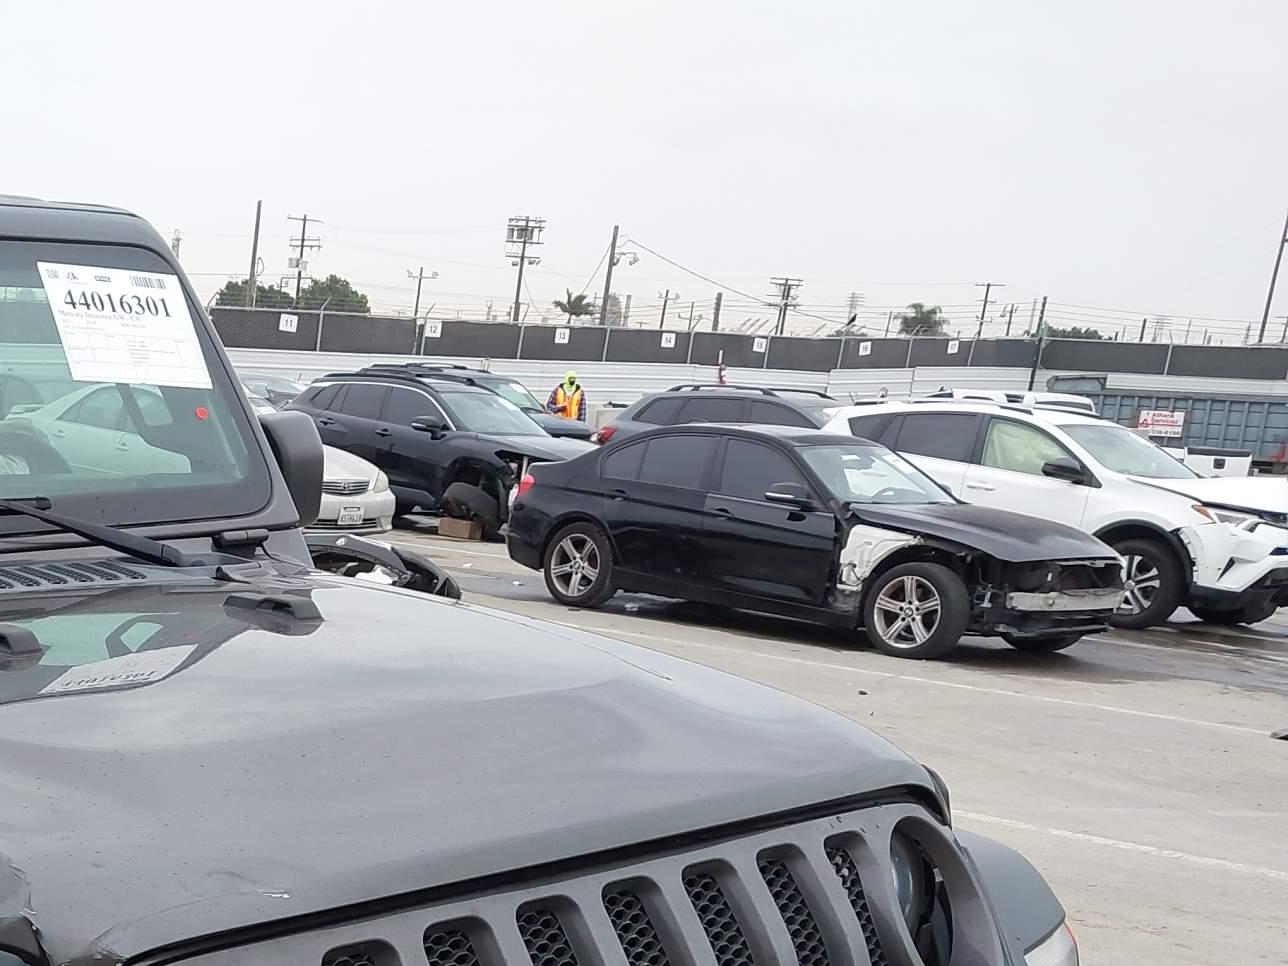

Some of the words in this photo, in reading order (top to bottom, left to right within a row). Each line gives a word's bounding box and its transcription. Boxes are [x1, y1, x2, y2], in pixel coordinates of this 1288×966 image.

[63, 289, 172, 318] 44016301
[284, 318, 294, 328] 11
[429, 325, 438, 334] 12
[664, 336, 673, 345] 14
